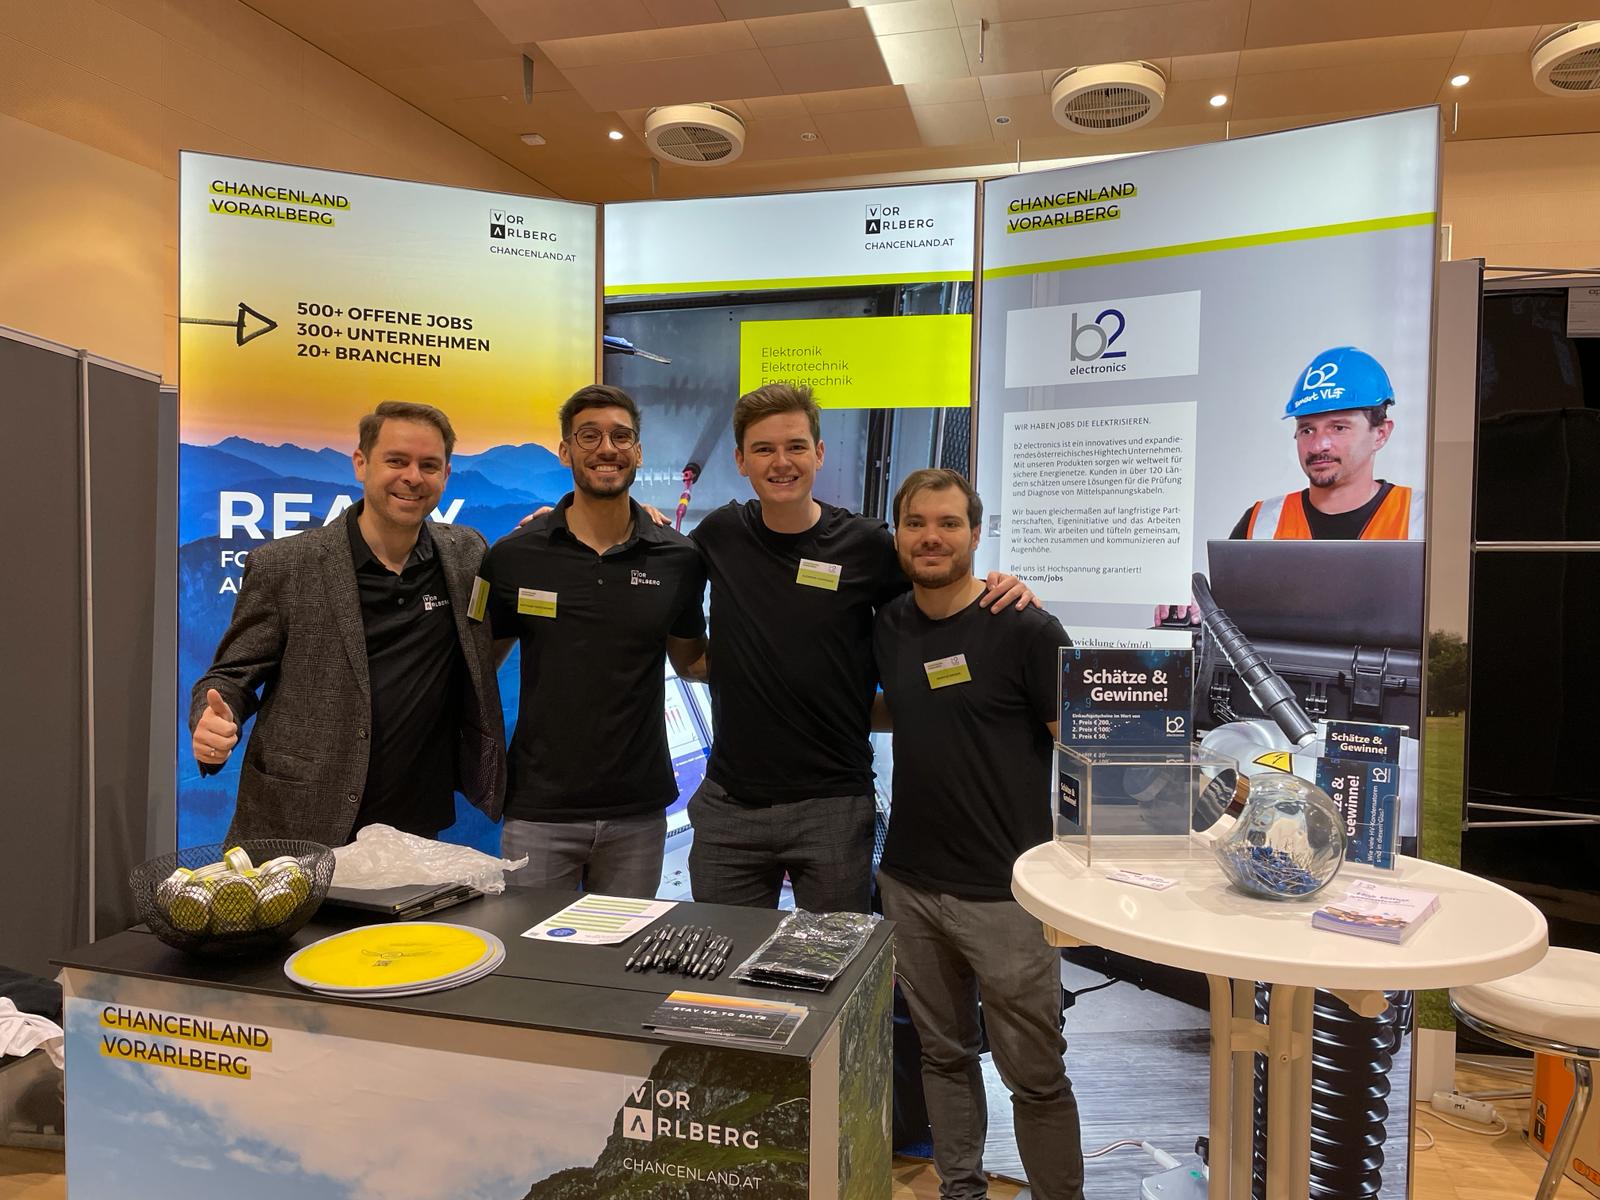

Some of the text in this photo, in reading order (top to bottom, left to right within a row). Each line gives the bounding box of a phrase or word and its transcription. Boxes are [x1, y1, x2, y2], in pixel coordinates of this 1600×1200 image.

[211, 180, 348, 208] CHANCENLAND
[1010, 182, 1135, 212] CHANCENLAND
[211, 199, 333, 225] VORARLBERG
[494, 213, 524, 224] VOR
[869, 206, 900, 217] VOR
[1010, 205, 1119, 231] VORARLBERG
[868, 218, 934, 232] ARLBERG
[494, 227, 556, 241] ARLBERG
[864, 238, 954, 251] CHANCENLAND.AT
[490, 246, 576, 262] CHANCENLAND.AT
[297, 302, 473, 330] 500+ OFFENE JOBS
[297, 323, 490, 352] 300+ UNTERNEHMEN
[1070, 309, 1127, 362] b2
[297, 344, 441, 367] 20+ BRANCHEN
[762, 346, 822, 357] Elektronik
[762, 360, 849, 372] Elektrotechnik
[1070, 363, 1126, 375] electronics
[1303, 363, 1338, 390] b2
[1077, 420, 1089, 428] DIE
[1092, 417, 1151, 427] ELEKTRISIEREN.
[1024, 441, 1060, 449] electronics
[1128, 437, 1143, 445] und
[1145, 436, 1182, 445] expandie-
[1014, 451, 1036, 459] rendes
[1037, 450, 1093, 458] österreichisches
[1094, 448, 1127, 457] Hightech
[1056, 459, 1092, 467] Produkten
[1095, 459, 1119, 467] sorgen
[1013, 470, 1037, 478] sichere
[1040, 470, 1086, 478] Energienetze.
[1089, 468, 1117, 476] Kunden
[1030, 479, 1060, 487] schätzen
[1088, 478, 1122, 486] Lösungen
[1138, 476, 1149, 484] die
[1151, 476, 1182, 485] Prüfung
[1013, 489, 1025, 497] und
[1028, 489, 1059, 498] Diagnose
[1077, 487, 1164, 496] Mittelspannungskabeln.
[1012, 508, 1023, 516] Wir
[1049, 507, 1101, 516] gleichermaßen
[1118, 507, 1160, 515] langfristige
[1012, 517, 1054, 525] nerschaften,
[1057, 517, 1108, 525] Eigeninitiative
[1134, 527, 1180, 535] gemeinsam,
[221, 551, 249, 568] FO
[1048, 566, 1100, 574] Hochspannung
[1102, 566, 1141, 574] garantiert!
[1071, 639, 1114, 648] wicklung
[1083, 669, 1168, 684] Schätze &
[1091, 687, 1168, 702] Gewinne!
[1166, 716, 1185, 733] b2
[1331, 733, 1382, 744] Schätze &
[1340, 743, 1388, 754] Gewinne!
[1372, 768, 1388, 783] b2
[1332, 778, 1344, 789] &
[1347, 775, 1360, 836] Gewinne!
[103, 1006, 269, 1047] CHANCENLAND
[103, 1034, 248, 1075] VORARLBERG
[632, 1086, 690, 1110] VOR
[630, 1114, 759, 1149] ARLBERG
[623, 1158, 762, 1190] CHANCENLAND.AT
